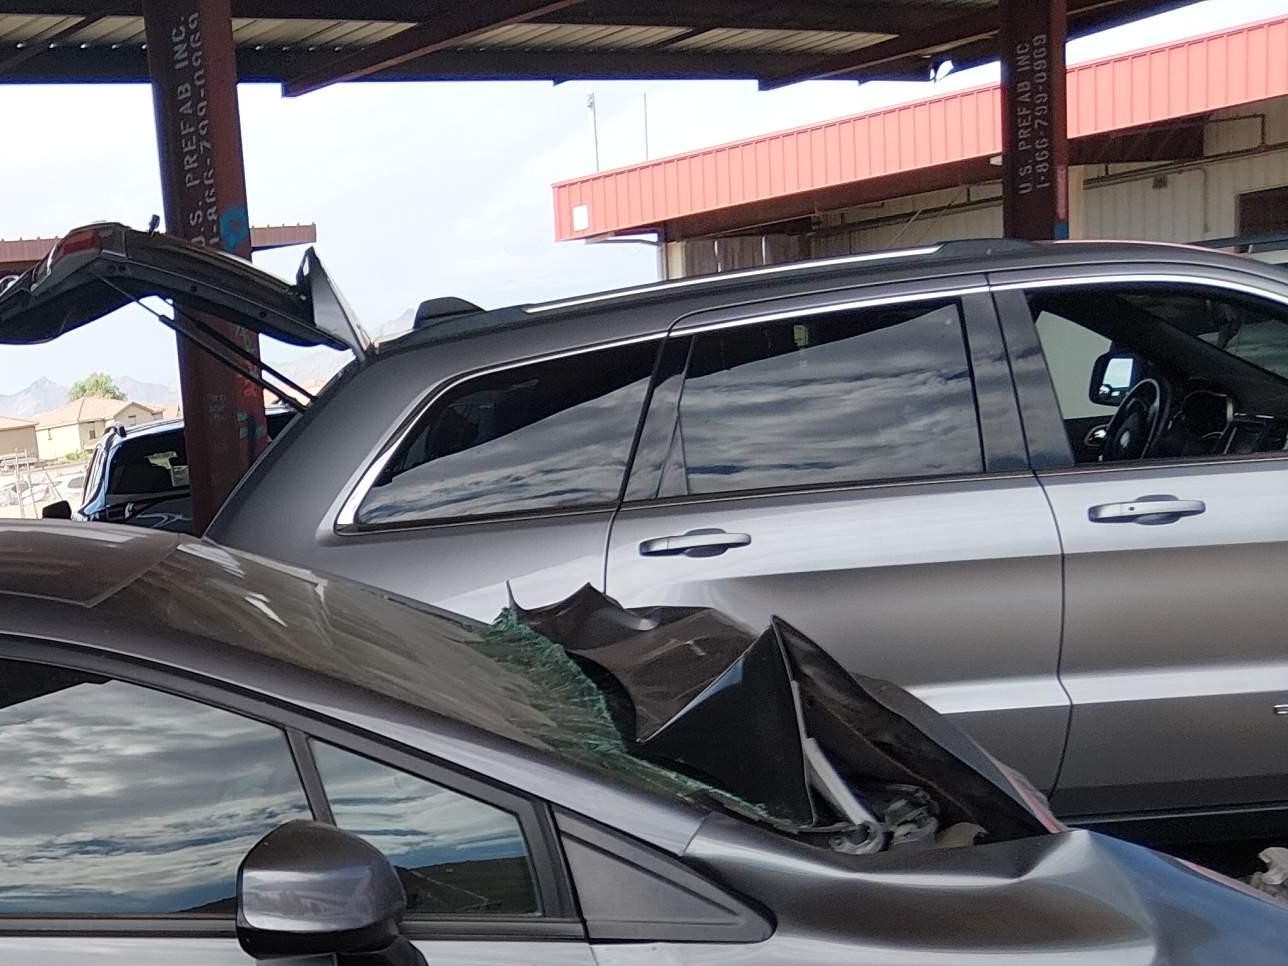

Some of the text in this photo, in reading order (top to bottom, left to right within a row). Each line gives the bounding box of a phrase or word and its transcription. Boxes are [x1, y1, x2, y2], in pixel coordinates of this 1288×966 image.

[172, 15, 187, 70] INC.
[177, 83, 201, 188] PREFAB
[1016, 80, 1033, 151] PREFAB
